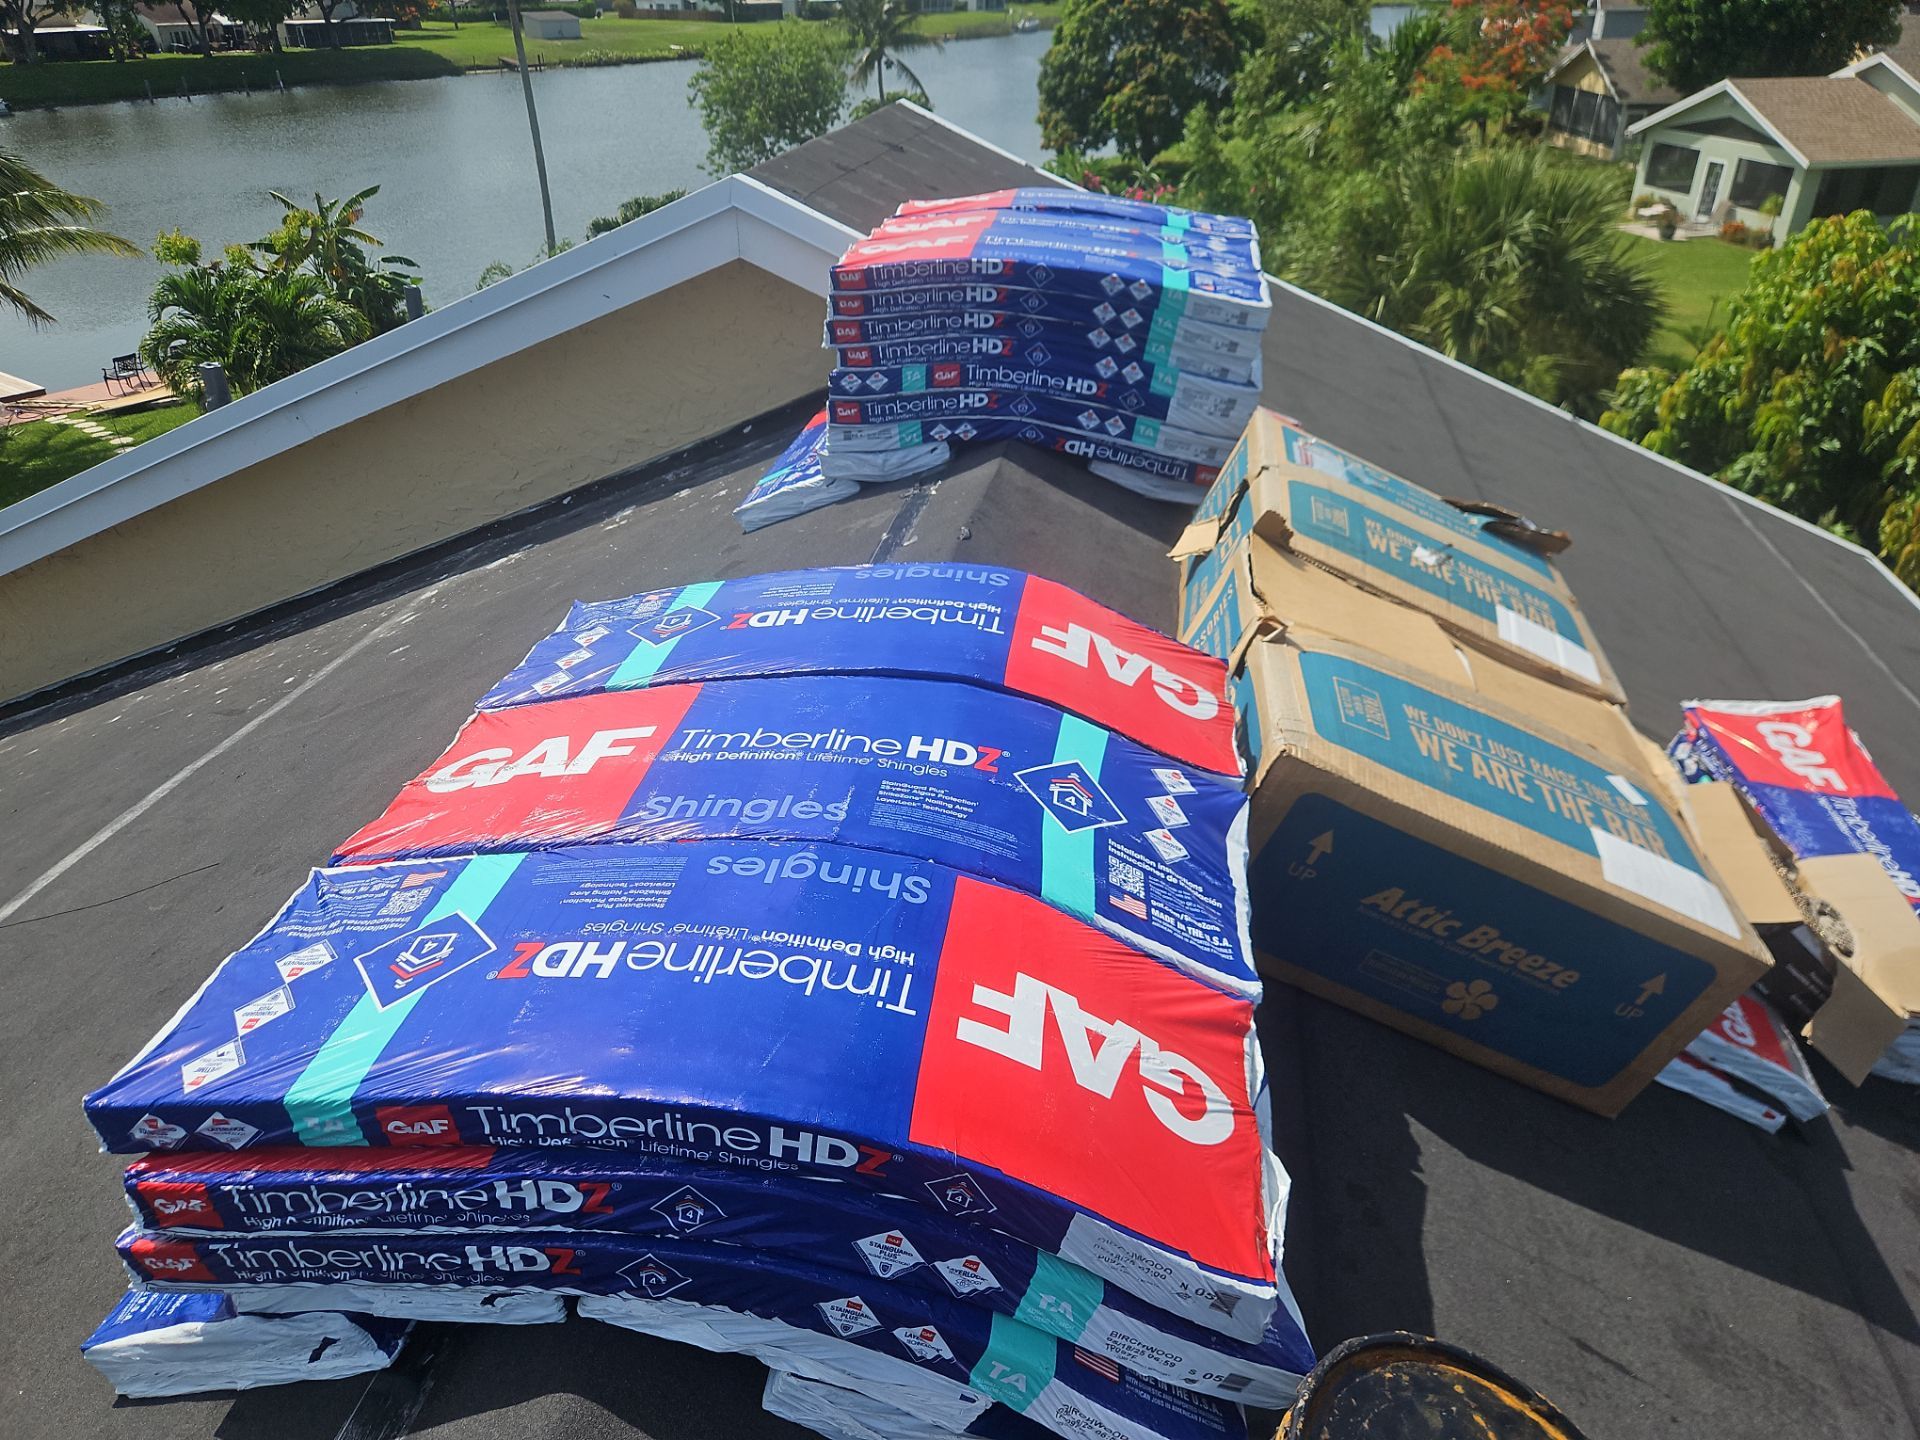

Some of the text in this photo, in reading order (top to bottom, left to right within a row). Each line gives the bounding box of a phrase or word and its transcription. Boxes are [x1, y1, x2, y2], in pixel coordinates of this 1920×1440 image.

[871, 258, 1018, 281] Timberline HDZ
[871, 290, 964, 307] Timberline
[865, 313, 1007, 335] Timberline HDZ
[878, 338, 1013, 360] Timberline HDZ
[934, 372, 959, 380] GAF
[966, 363, 1108, 398] Timberline HDZ
[866, 393, 998, 415] Timberline HDZ
[1055, 437, 1096, 459] HDZ
[1097, 446, 1189, 482] Timberline
[855, 566, 1011, 587] Shingles
[1367, 528, 1404, 562] WE
[1462, 572, 1502, 605] THE
[811, 606, 1005, 635] Timberline
[1031, 622, 1219, 721] GAF
[680, 727, 903, 756] Timberline
[1403, 704, 1433, 728] WE
[1433, 715, 1484, 750] DON'T
[1487, 739, 1529, 770] JUST
[1530, 754, 1582, 793] RAISE
[426, 726, 658, 793] GAF
[876, 758, 948, 777] Shingles
[1409, 725, 1671, 860] WE ARE THE BAR
[640, 794, 849, 824] Shingles
[922, 803, 968, 819] Technology
[954, 804, 974, 813] Area
[1108, 838, 1157, 868] Installation
[1108, 845, 1178, 884] Instrucciones de
[1287, 864, 1320, 881] UP
[706, 852, 931, 903] Shingles
[583, 918, 663, 935] Shingles
[1151, 907, 1176, 926] MADE
[1358, 886, 1464, 940] Attic
[1456, 923, 1585, 991] Breeze
[867, 945, 915, 966] High
[627, 940, 917, 1016] Timberline
[1614, 1002, 1645, 1020] UP
[956, 971, 1236, 1146] GAF
[387, 1119, 449, 1136] GAF
[465, 1106, 761, 1151] Timberline
[718, 1151, 799, 1171] Shingles
[154, 1198, 206, 1214] GAF
[220, 1182, 488, 1214] Timberline
[244, 1215, 281, 1230] High
[209, 1240, 462, 1272] Timberline
[869, 1240, 914, 1257] STAINGUARD
[1179, 1282, 1216, 1300] N 05
[1109, 1330, 1183, 1363] BIRCHWOOD
[989, 1360, 1027, 1393] TA
[1187, 1368, 1225, 1383] S 05
[1171, 1384, 1189, 1401] THE
